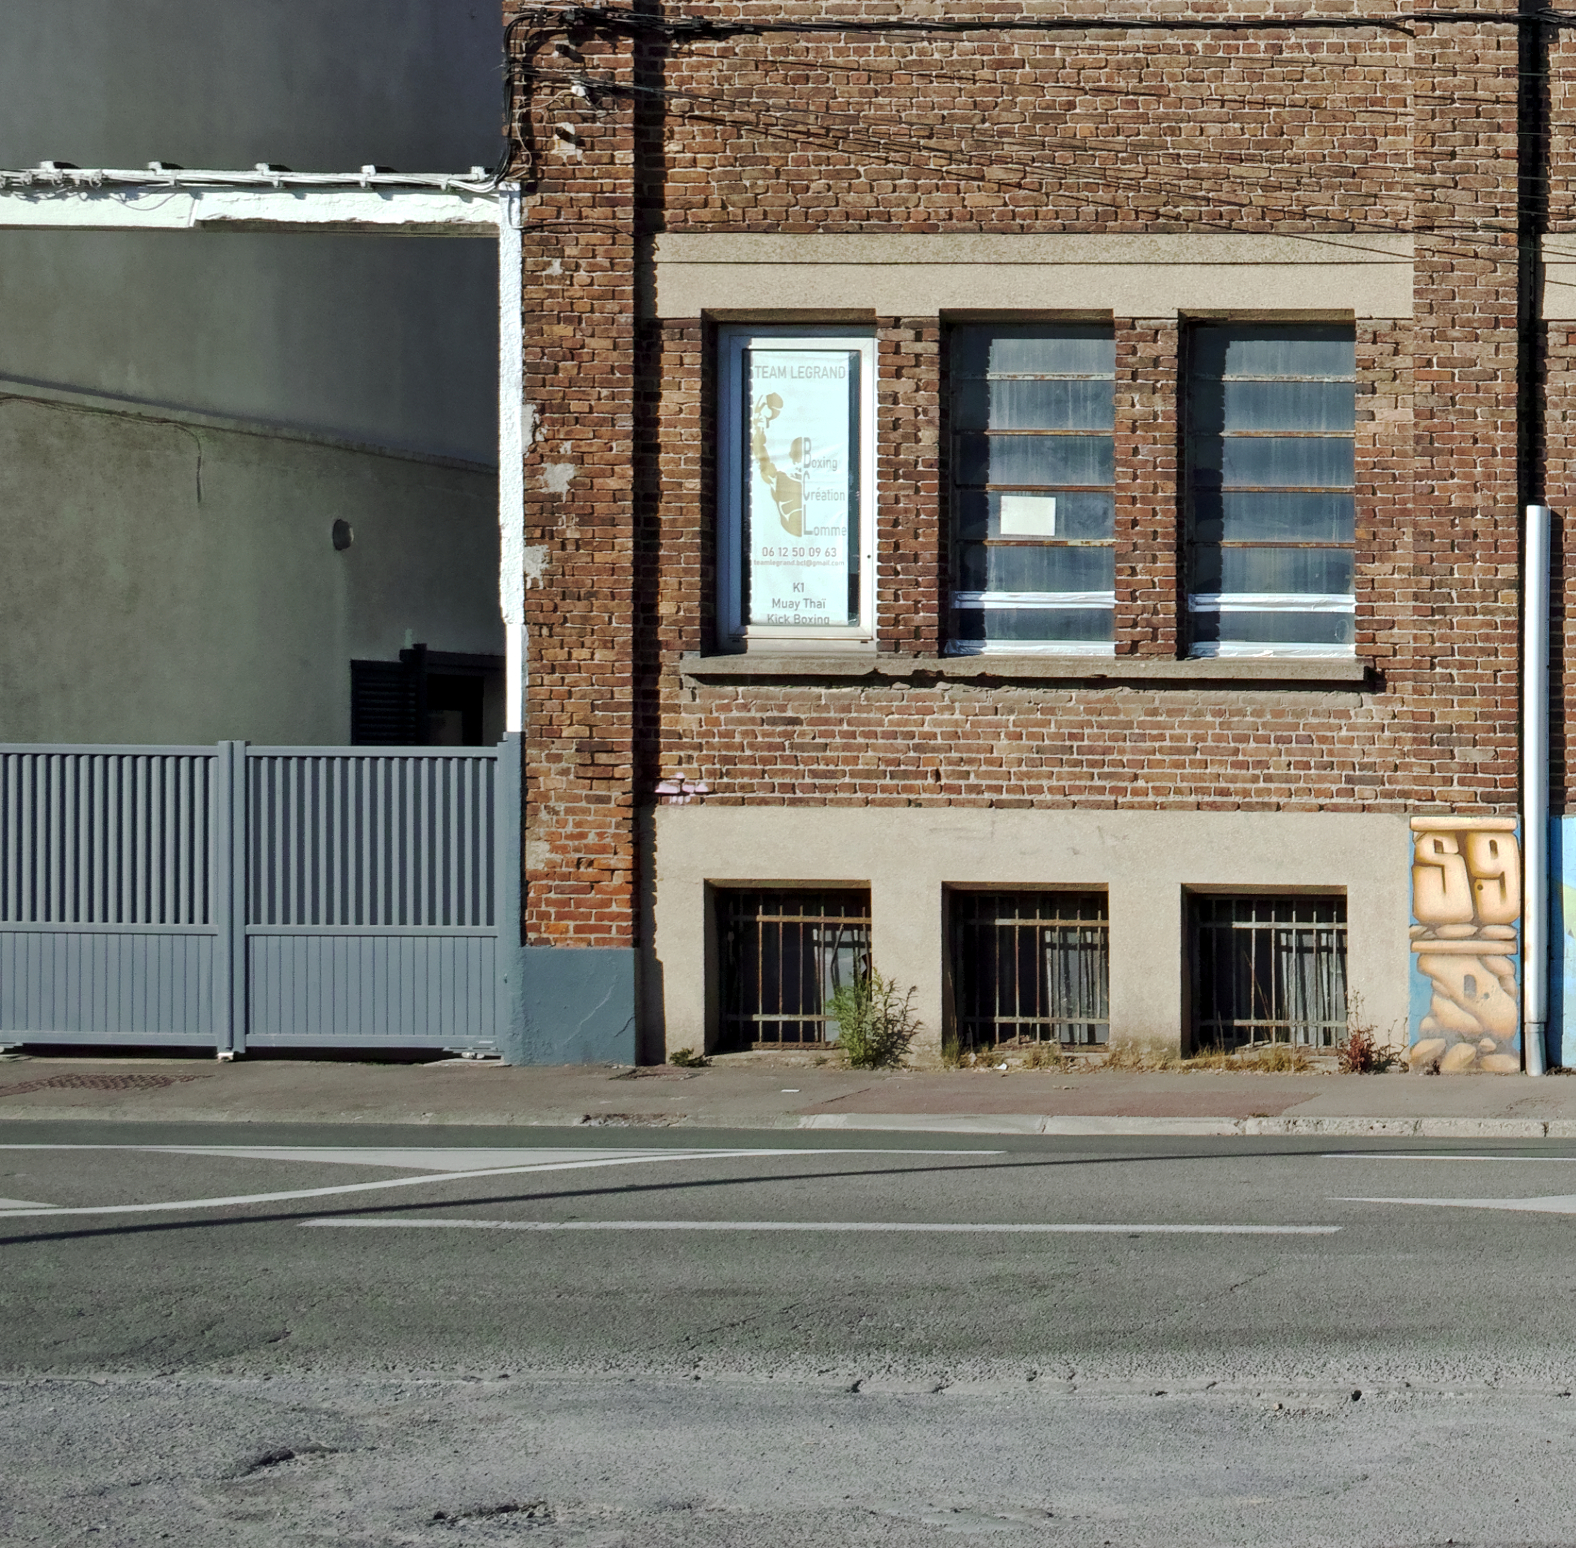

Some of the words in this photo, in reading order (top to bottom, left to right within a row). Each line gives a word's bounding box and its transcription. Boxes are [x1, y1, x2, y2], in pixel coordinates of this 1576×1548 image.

[755, 365, 787, 379] TEAM
[790, 365, 846, 379] LEGRAND
[803, 437, 838, 471] Boxing
[802, 470, 845, 501] Création
[803, 504, 847, 536] Lomme
[762, 547, 775, 557] 06
[778, 547, 789, 557] 12
[792, 547, 805, 557] 50
[808, 547, 821, 557] 09
[824, 547, 837, 558] 63
[792, 582, 805, 593] K1
[771, 598, 800, 611] Muay
[803, 598, 826, 609] Thaï
[767, 614, 791, 625] Kick
